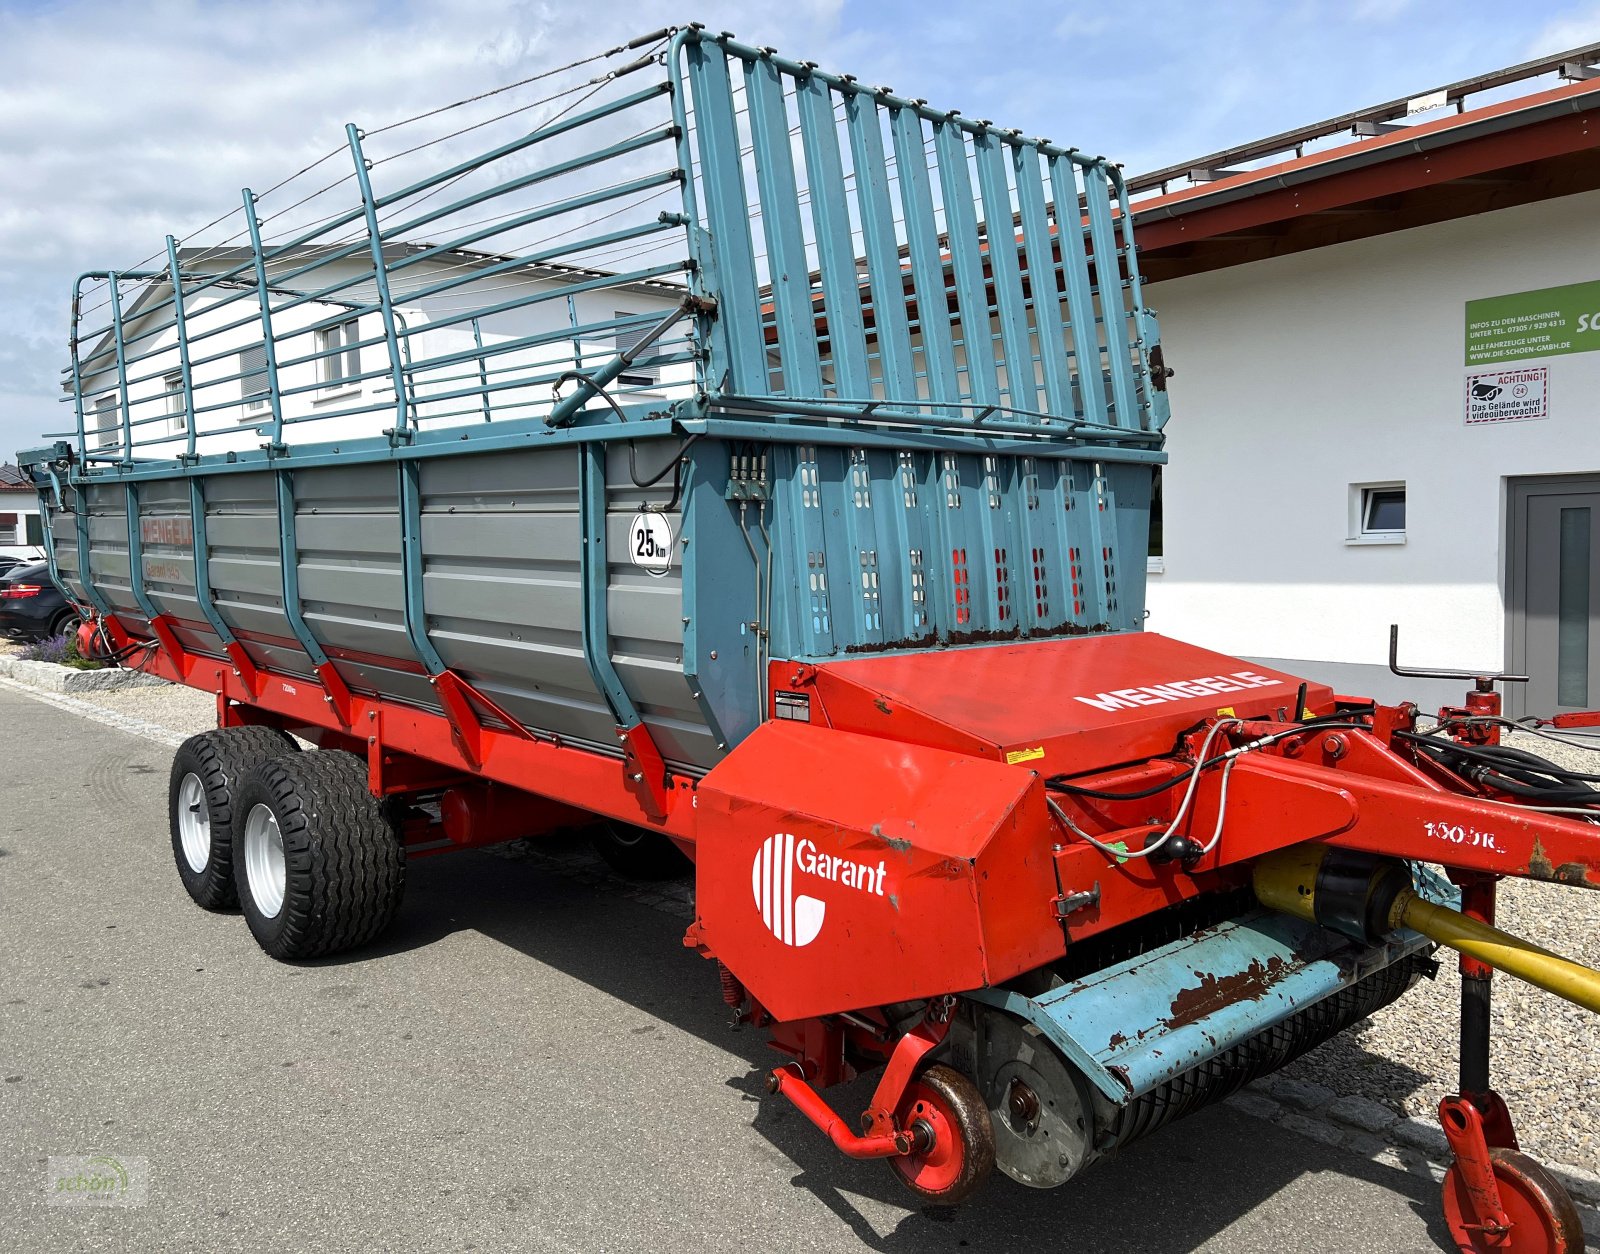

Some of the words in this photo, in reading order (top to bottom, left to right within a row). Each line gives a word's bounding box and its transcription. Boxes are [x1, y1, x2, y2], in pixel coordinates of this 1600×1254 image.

[1470, 321, 1490, 330] INFOS
[1501, 317, 1516, 325] DEN
[1517, 311, 1560, 323] MASCHINEN
[1470, 330, 1491, 339] UNTER
[1507, 324, 1528, 333] 07305
[1534, 322, 1547, 330] 929
[1470, 343, 1486, 352] ALLE
[1486, 338, 1526, 350] FAHRZEUGE
[1527, 335, 1551, 344] UNTER
[1470, 341, 1571, 360] WWW.DIE-SCHOEN-GMBH.DE
[1498, 372, 1542, 385] ACHTUNG!
[1472, 404, 1487, 412] Das
[1488, 400, 1521, 411] Gelände
[1523, 398, 1541, 407] wird
[1472, 406, 1540, 419] videoüberwacht!
[636, 528, 655, 558] 25
[655, 543, 666, 558] km
[1072, 671, 1285, 712] MENGELE
[796, 838, 887, 896] Garant
